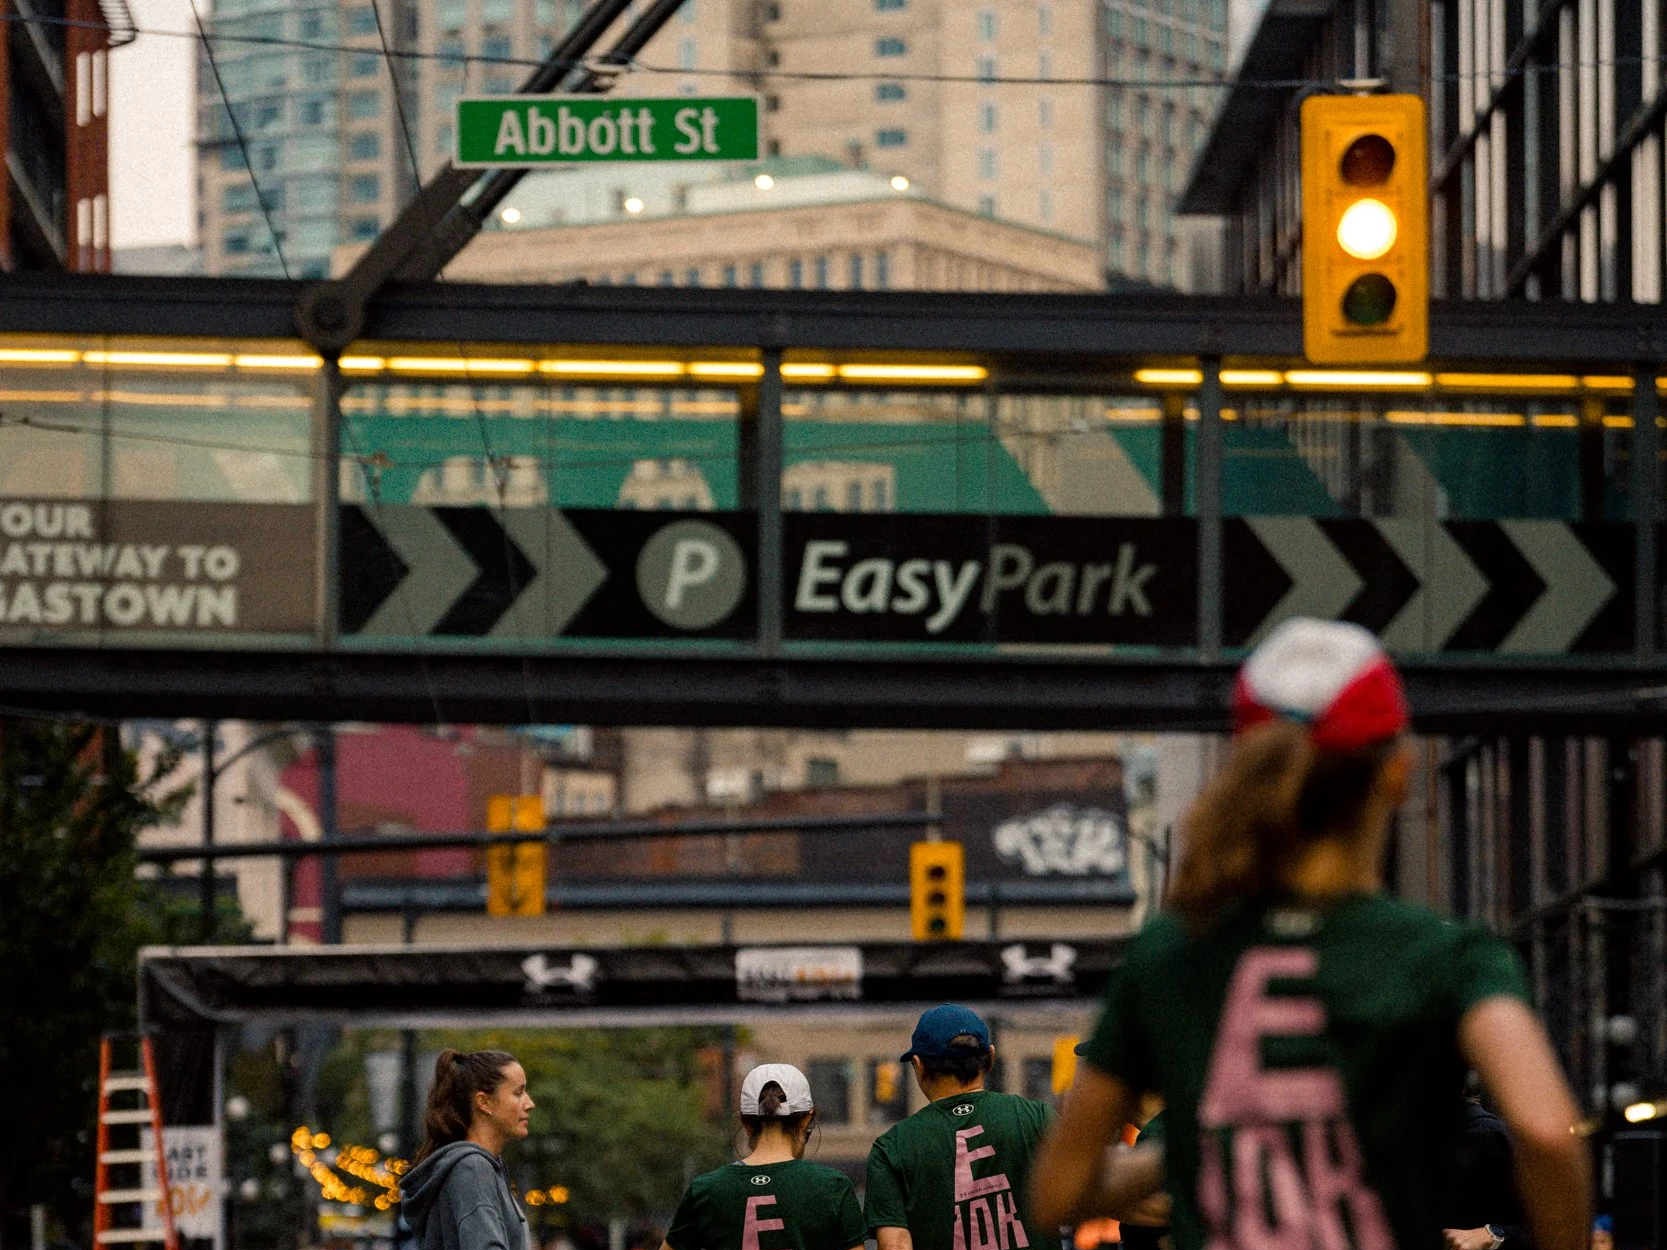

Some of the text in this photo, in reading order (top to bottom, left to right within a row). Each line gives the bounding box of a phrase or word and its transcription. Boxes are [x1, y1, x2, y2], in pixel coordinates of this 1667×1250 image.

[494, 106, 721, 155] Abbott St
[0, 502, 92, 538] OUR
[0, 542, 240, 581] ATEWAY TO
[665, 539, 719, 610] P
[795, 539, 1157, 634] EasyPark
[1198, 945, 1345, 1128] E
[954, 1124, 1011, 1203] E
